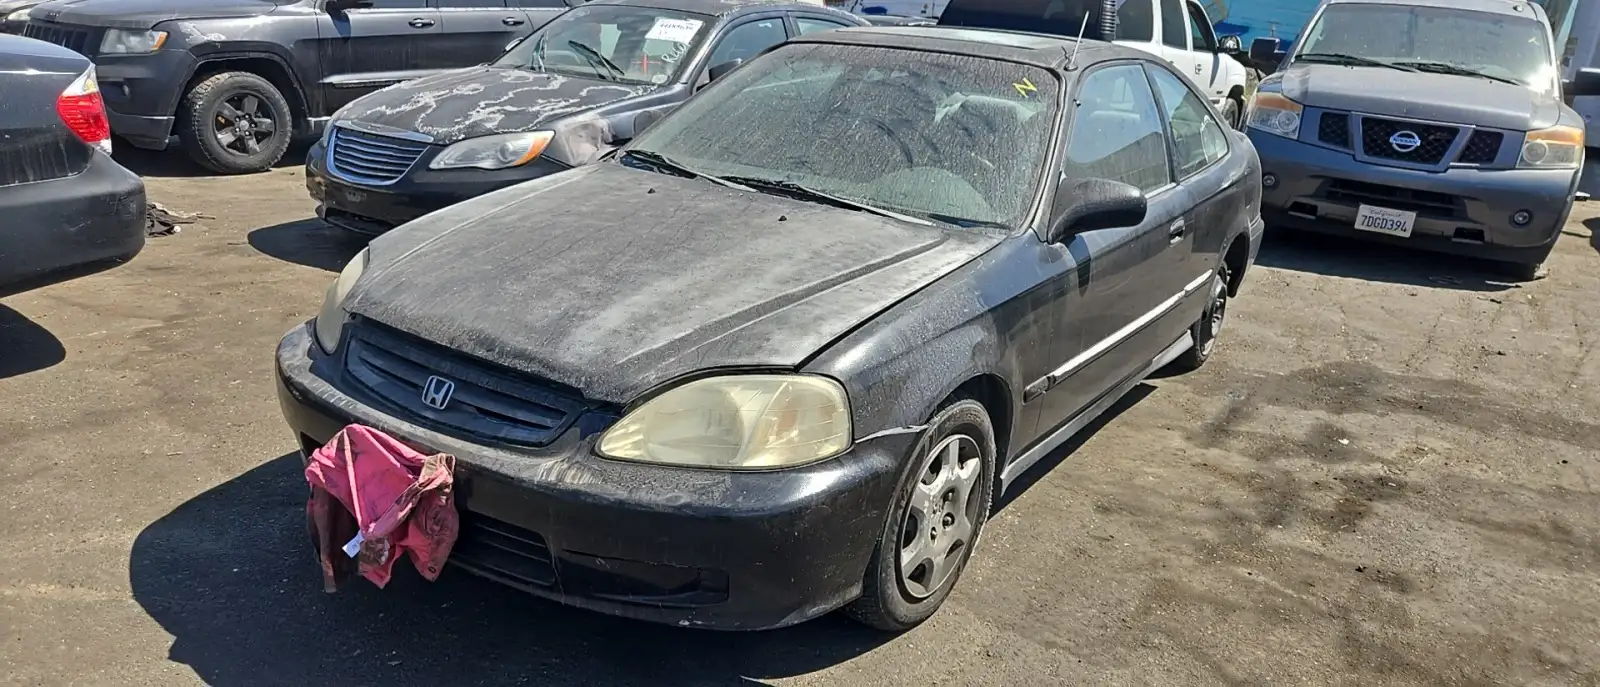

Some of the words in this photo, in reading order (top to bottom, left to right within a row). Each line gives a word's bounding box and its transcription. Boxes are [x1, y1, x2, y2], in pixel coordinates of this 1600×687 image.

[1012, 77, 1037, 98] N
[1392, 137, 1418, 145] NISSAN
[1361, 214, 1407, 232] 7DGD394
